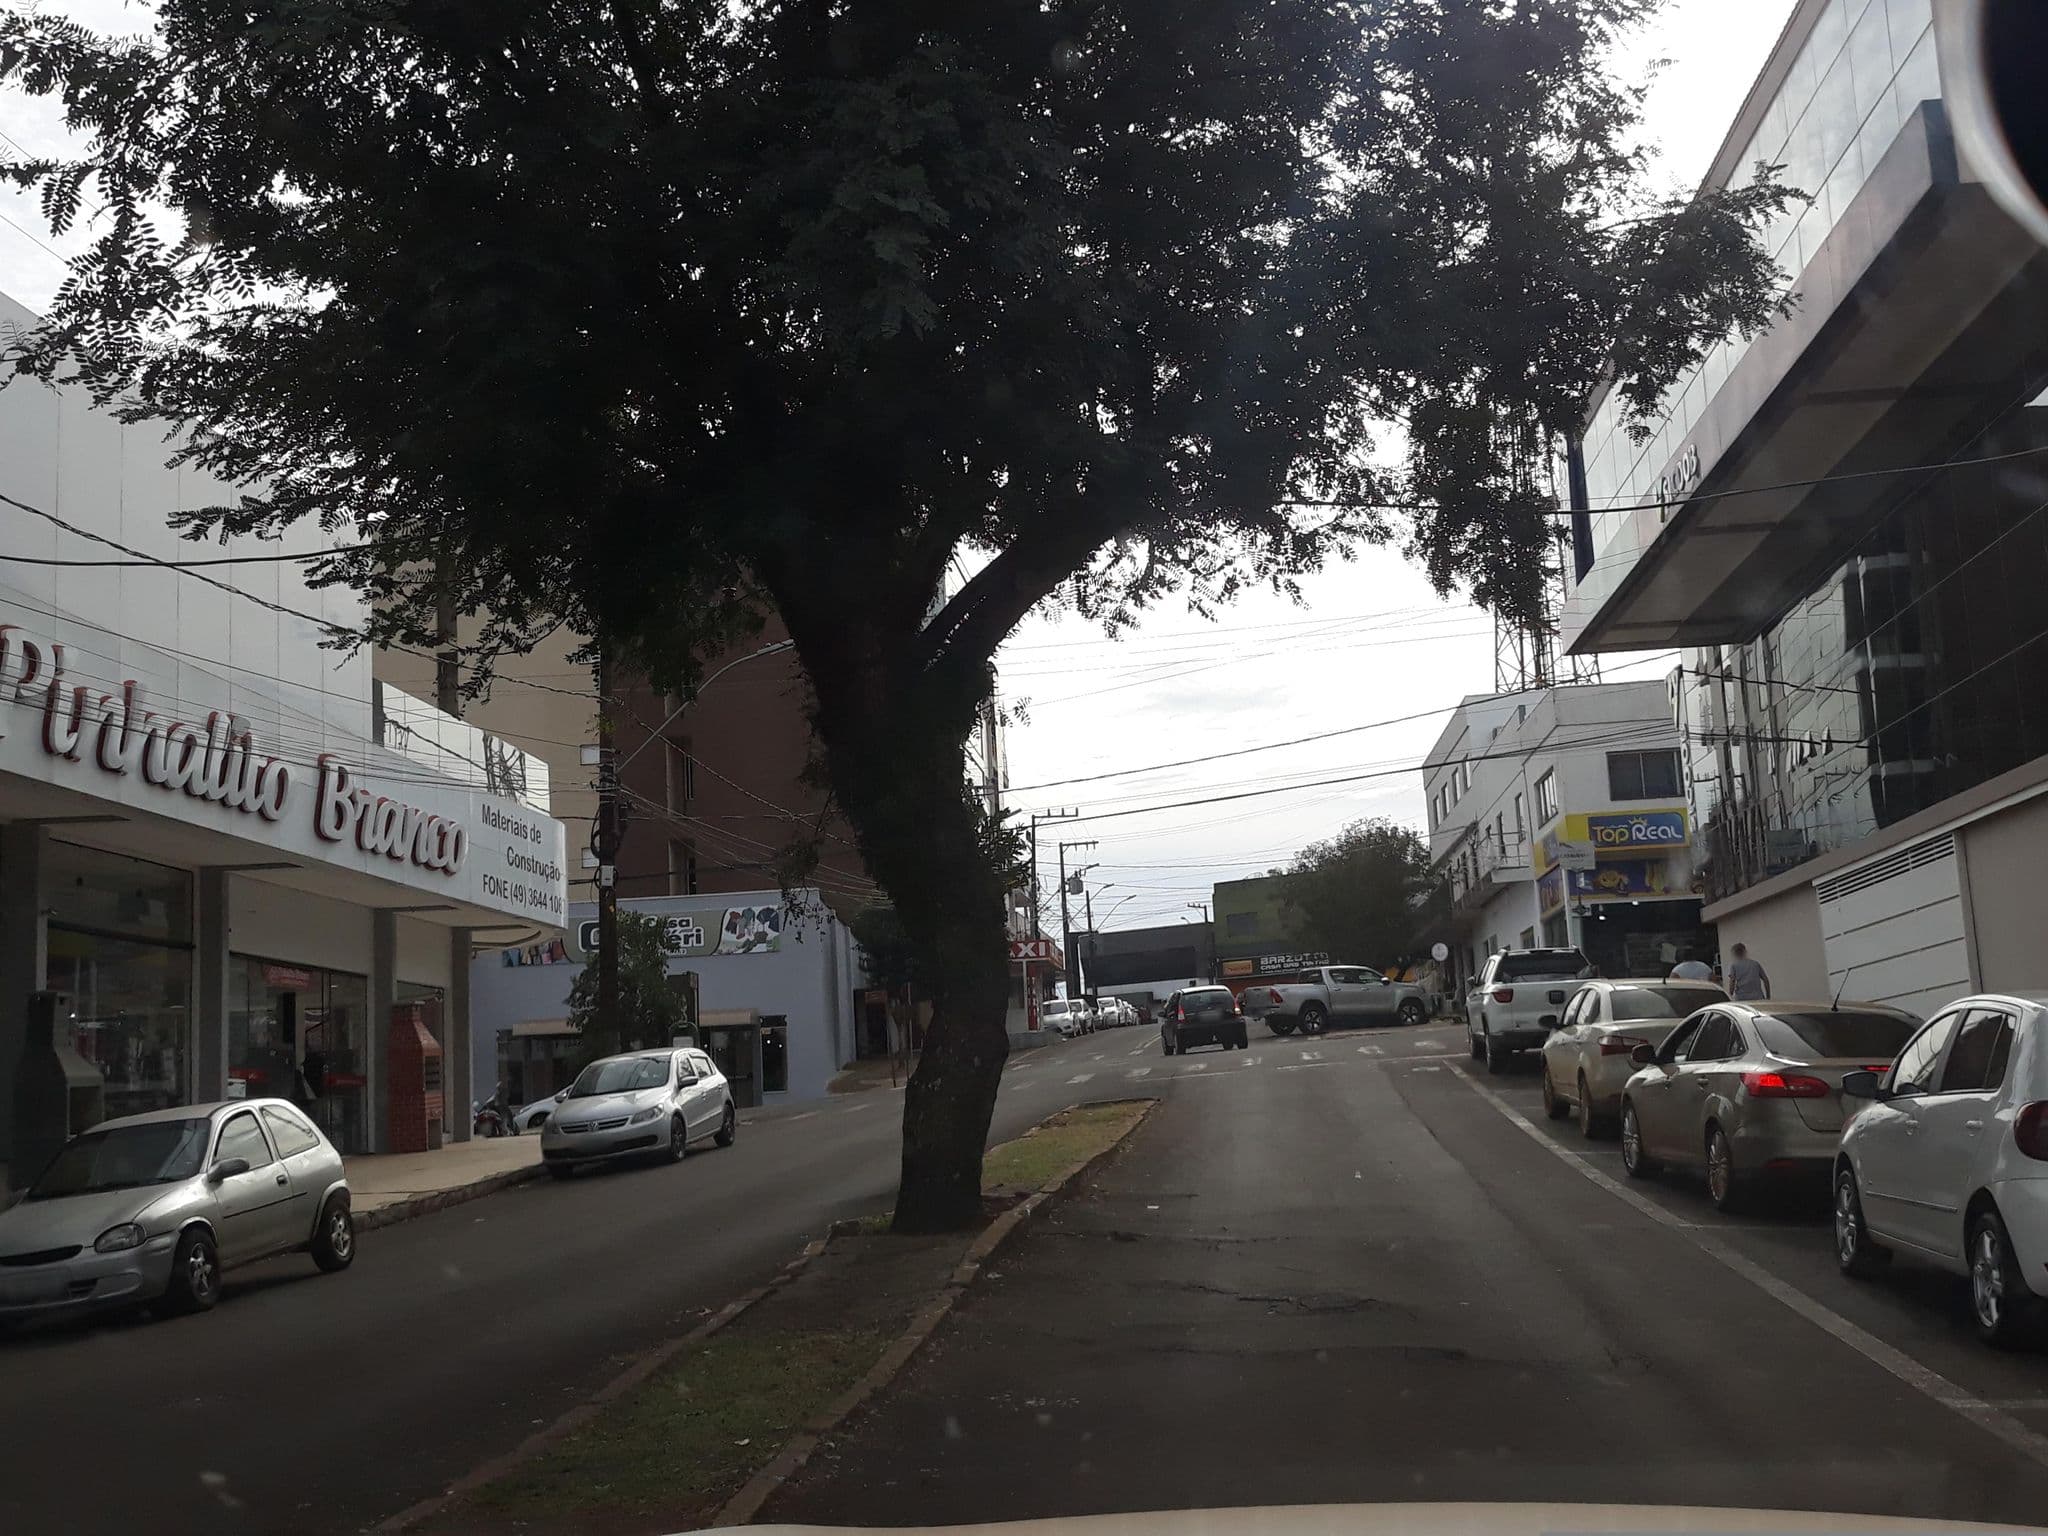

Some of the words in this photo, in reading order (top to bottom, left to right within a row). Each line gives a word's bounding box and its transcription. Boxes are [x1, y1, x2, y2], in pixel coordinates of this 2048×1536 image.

[314, 753, 469, 877] Branco
[482, 804, 528, 839] Materiais
[530, 824, 541, 844] de
[506, 846, 561, 883] Construção
[483, 874, 509, 900] FONE
[511, 882, 527, 908] (49)
[528, 888, 548, 910] 3644
